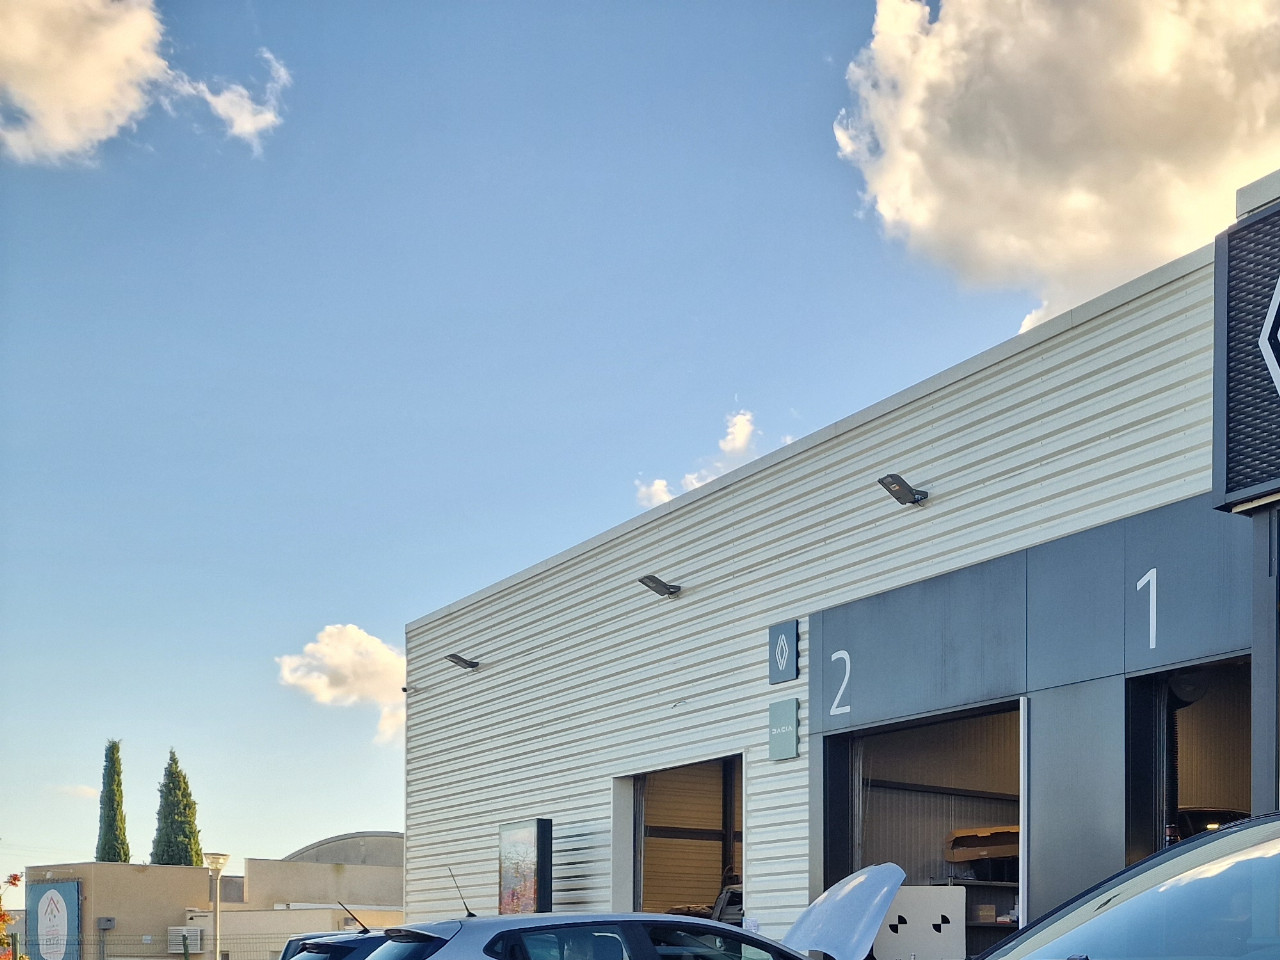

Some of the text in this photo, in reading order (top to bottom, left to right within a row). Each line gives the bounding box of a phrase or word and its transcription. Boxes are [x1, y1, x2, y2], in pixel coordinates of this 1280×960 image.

[1136, 567, 1157, 649] 1
[829, 649, 851, 716] 2
[771, 725, 793, 735] DACIA
